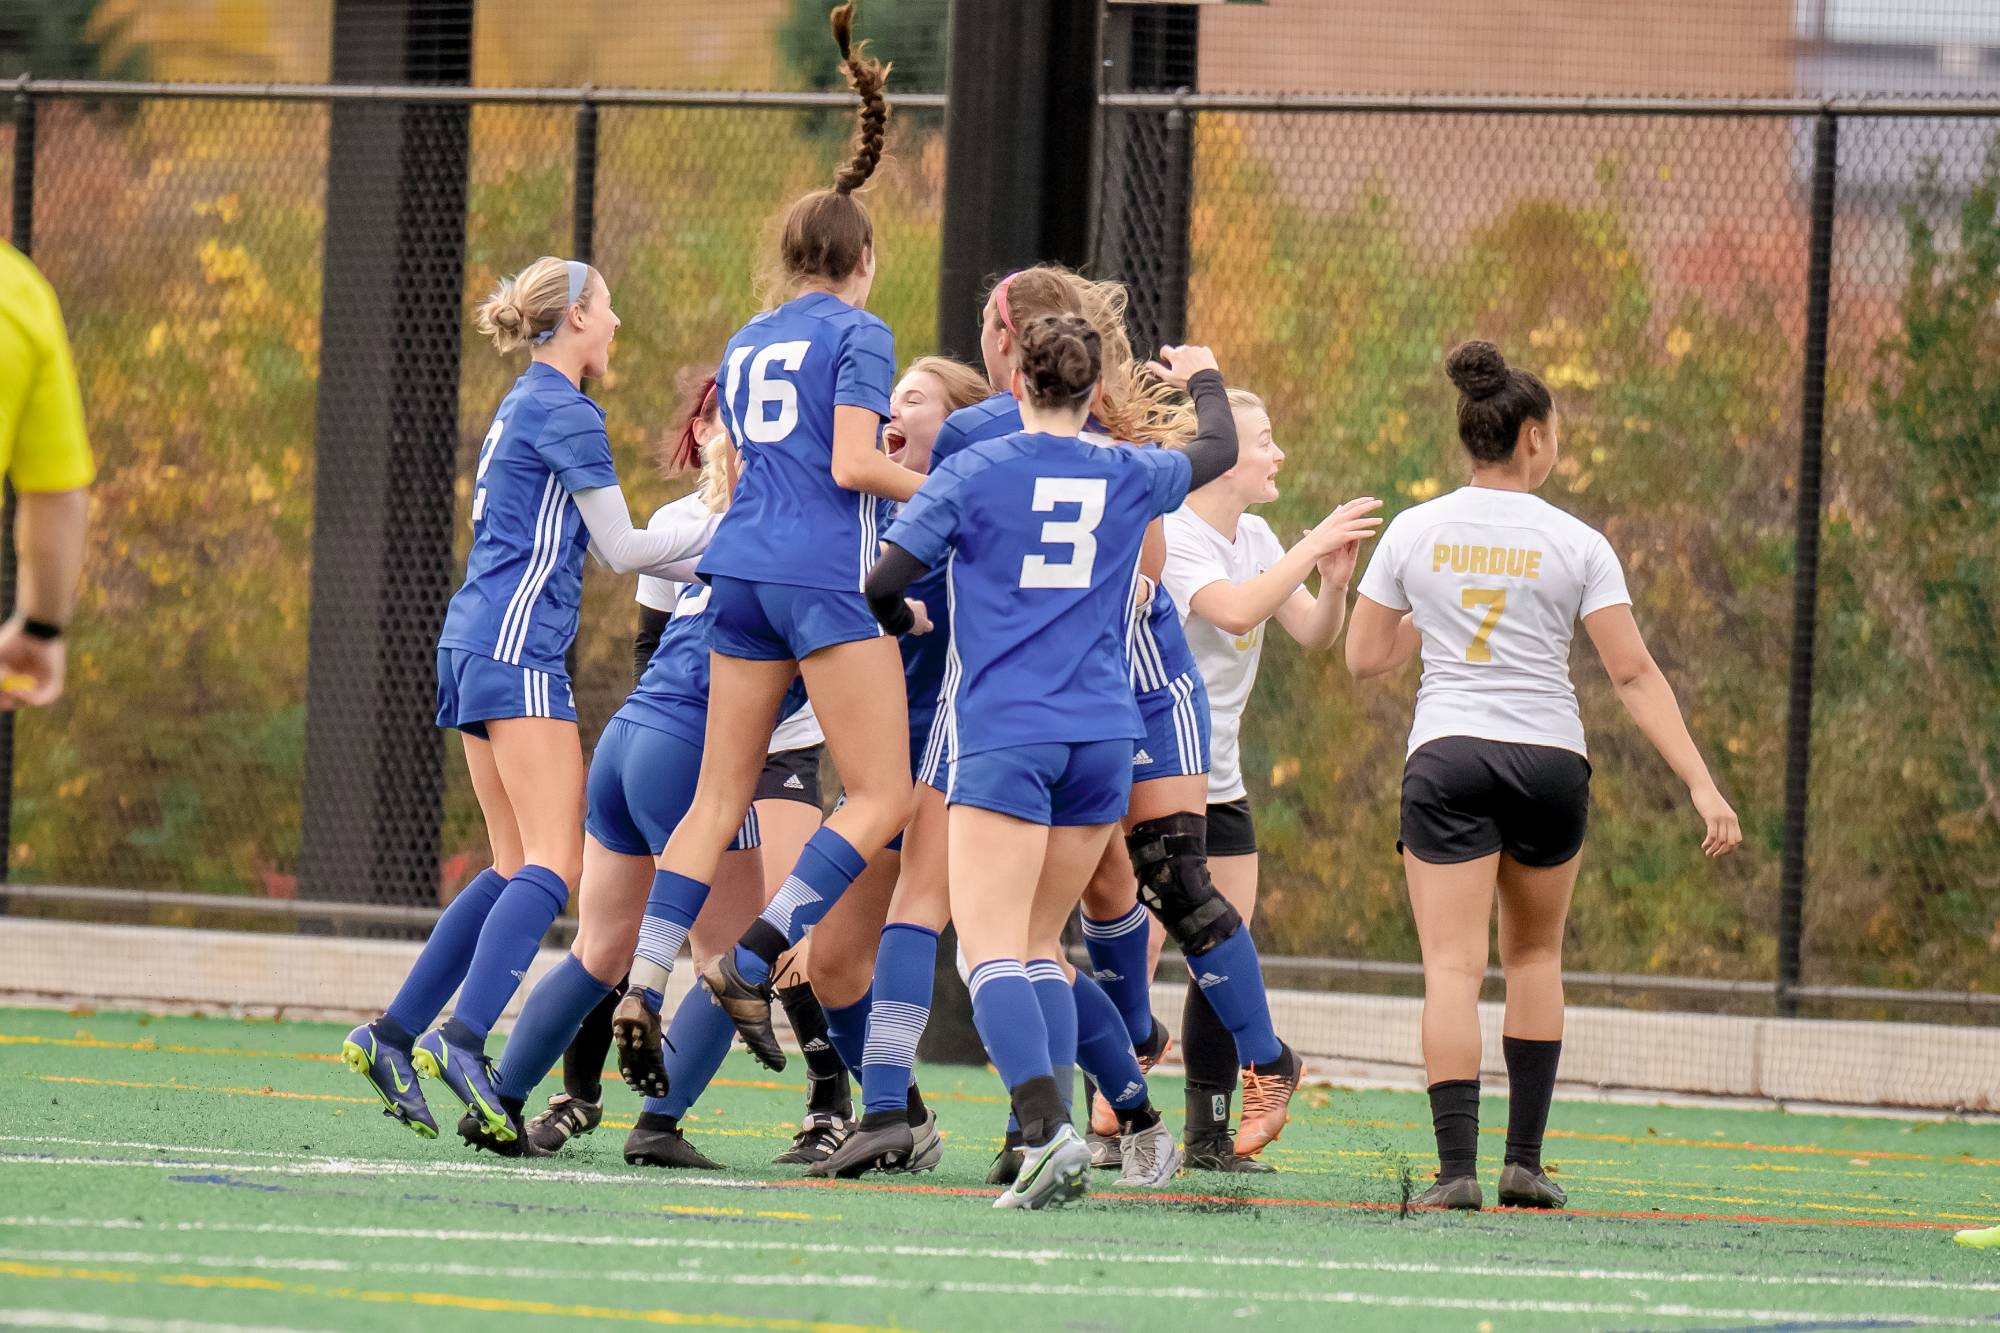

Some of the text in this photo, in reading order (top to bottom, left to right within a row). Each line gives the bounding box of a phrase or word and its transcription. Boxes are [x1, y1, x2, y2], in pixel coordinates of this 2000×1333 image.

[725, 340, 812, 449] 16
[1019, 477, 1107, 588] 3
[1431, 543, 1542, 579] PURDUE
[1461, 588, 1506, 662] 7
